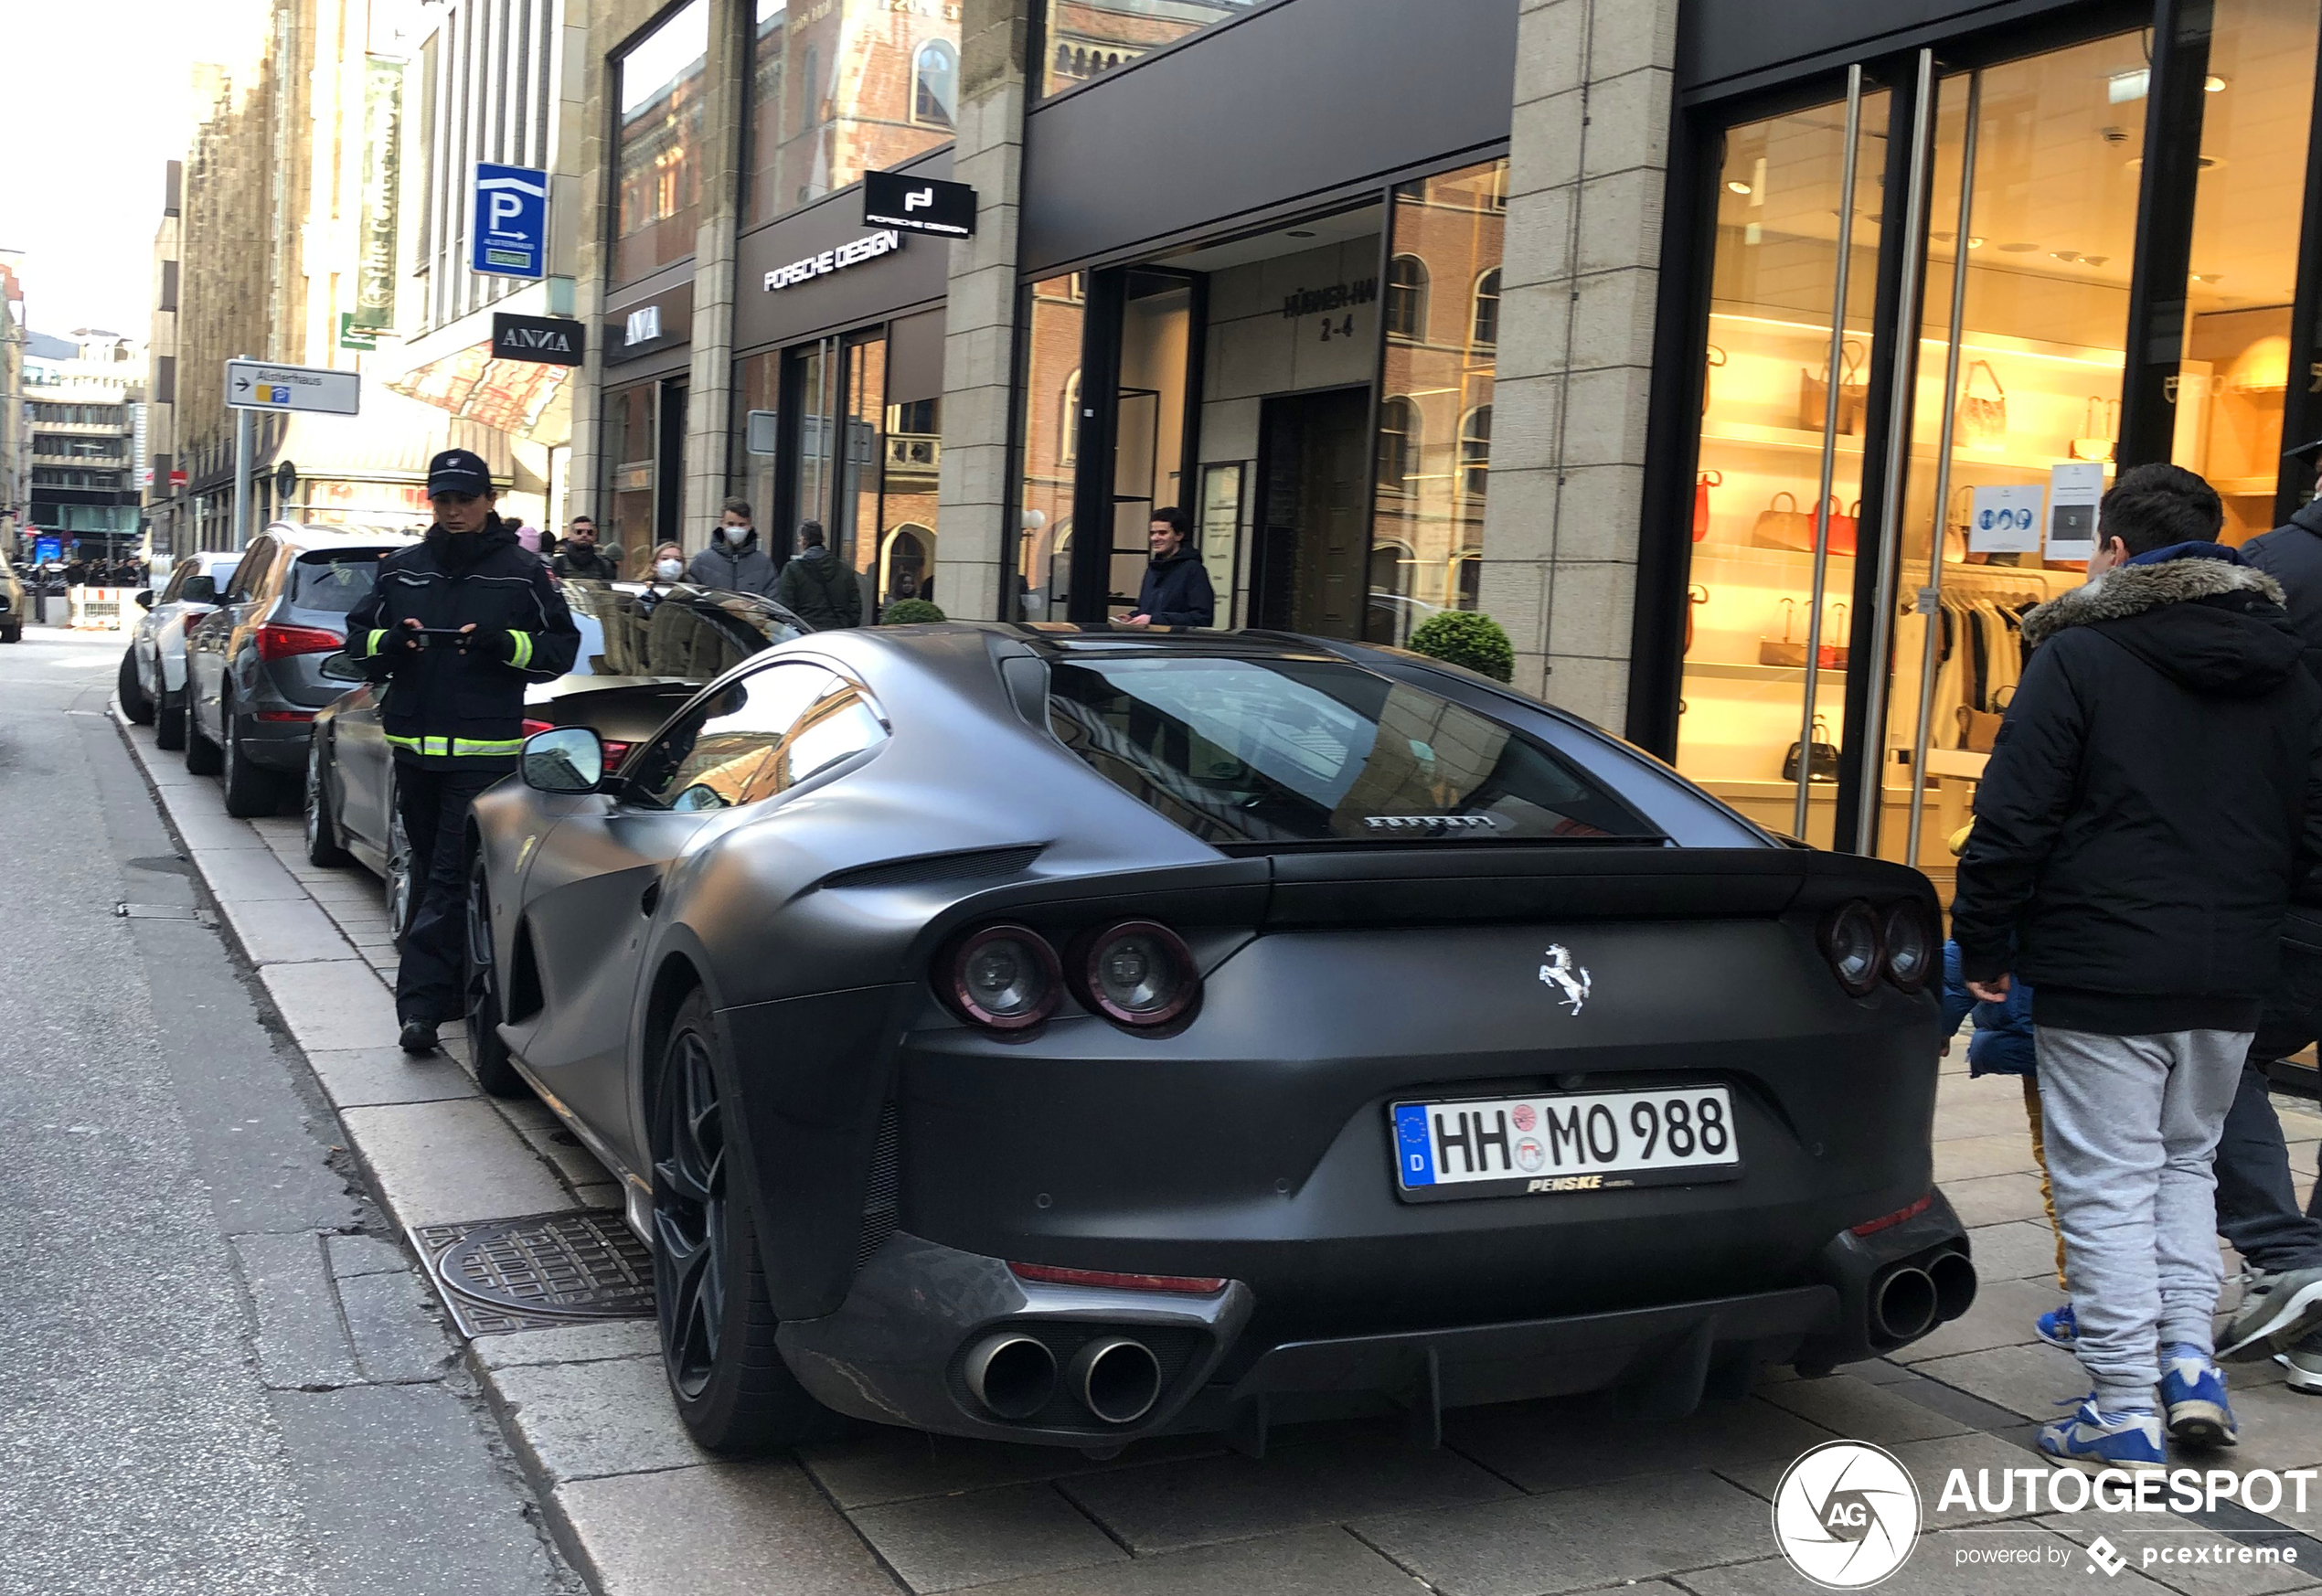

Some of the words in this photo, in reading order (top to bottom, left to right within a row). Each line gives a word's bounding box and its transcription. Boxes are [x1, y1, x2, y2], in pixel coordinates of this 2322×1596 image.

[489, 191, 524, 230] P
[867, 215, 923, 229] PORSCHE
[924, 222, 969, 234] DESIGN
[764, 250, 834, 292] PORSCHE
[836, 230, 899, 268] DESIGN
[255, 370, 323, 386] Alsterhaus
[1434, 1110, 1511, 1174] HH
[1547, 1103, 1619, 1166] MO
[1630, 1097, 1729, 1159] 988
[1410, 1154, 1425, 1173] D
[1526, 1175, 1603, 1193] PENSKE
